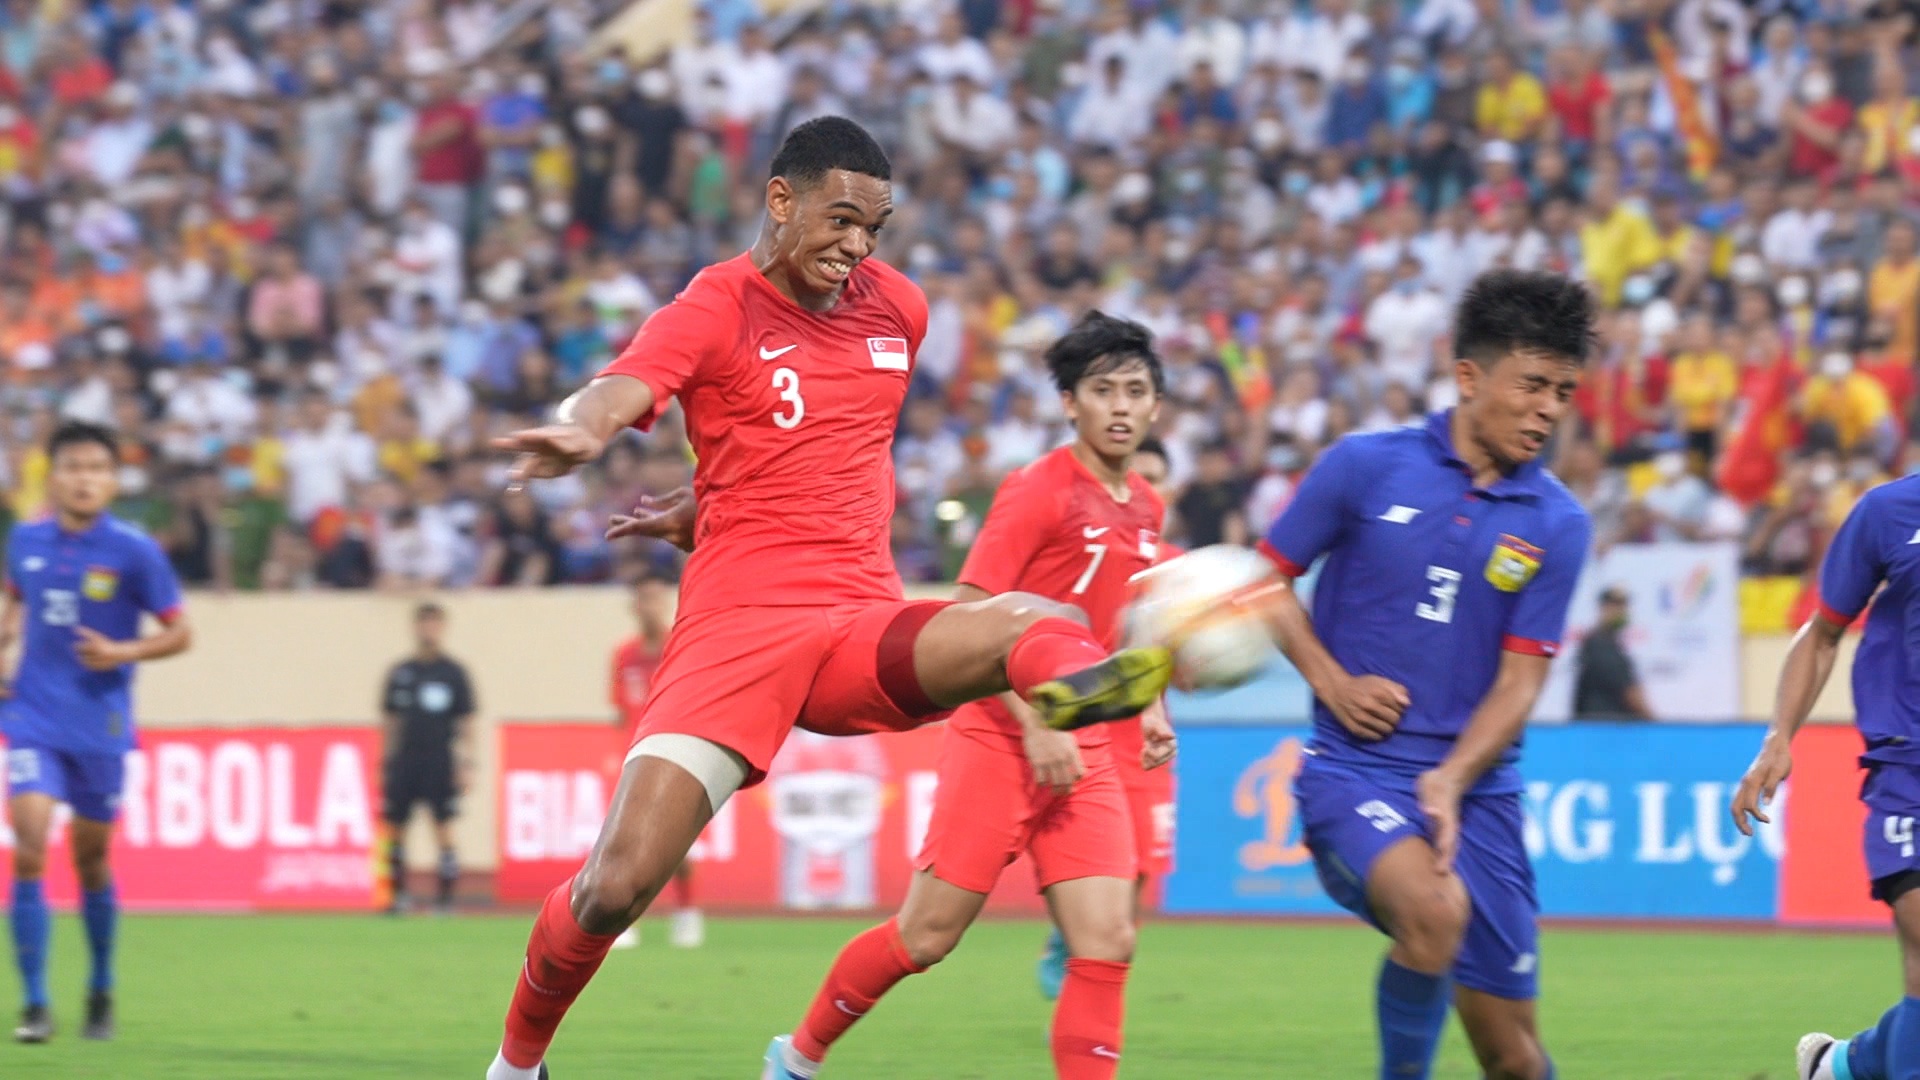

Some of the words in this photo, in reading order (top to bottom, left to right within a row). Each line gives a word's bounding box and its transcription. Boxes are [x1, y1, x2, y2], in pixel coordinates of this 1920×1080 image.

[772, 367, 805, 429] 3
[1072, 544, 1107, 594] 7
[1415, 564, 1463, 624] 3
[507, 769, 609, 860] BIA
[1883, 815, 1916, 857] 4
